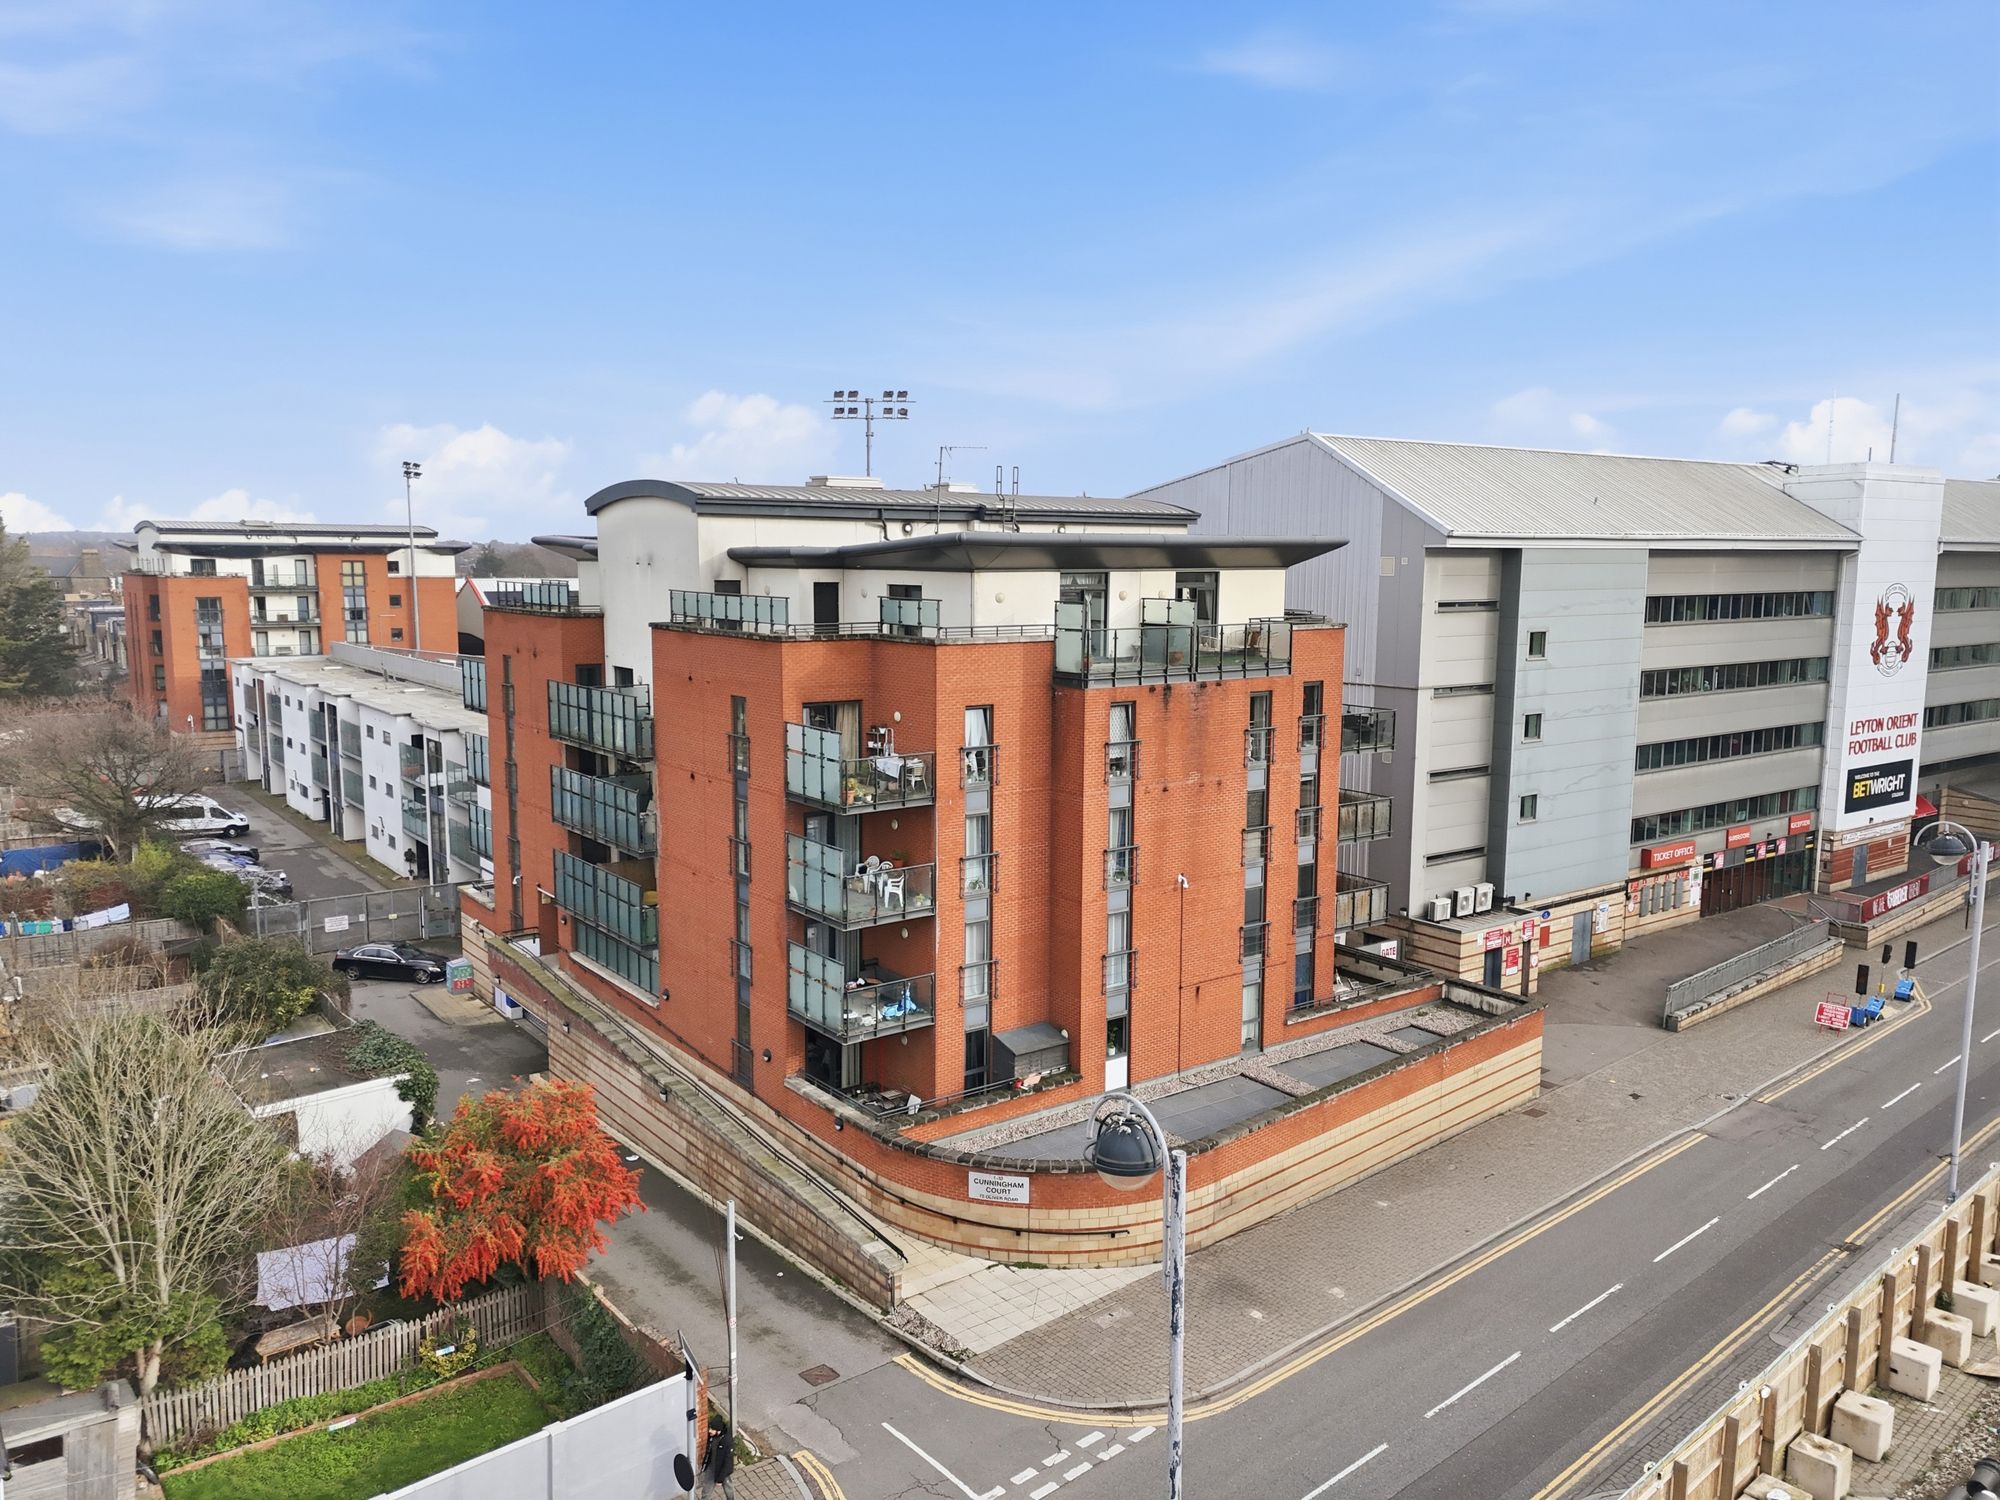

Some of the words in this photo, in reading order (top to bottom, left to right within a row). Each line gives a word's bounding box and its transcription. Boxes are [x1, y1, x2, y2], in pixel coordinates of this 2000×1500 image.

[1850, 717, 1884, 737] LEYTON
[1886, 712, 1919, 731] ORIENT
[1848, 735, 1893, 756] FOOTBALL
[1895, 732, 1917, 749] CLUB
[1852, 773, 1906, 799] BETWRIGHT
[1653, 850, 1673, 862] TICKET
[1674, 845, 1694, 858] OFFICE
[1382, 946, 1396, 957] GATE
[973, 1177, 1024, 1188] CUNNINGHAM
[985, 1186, 1012, 1195] COURT
